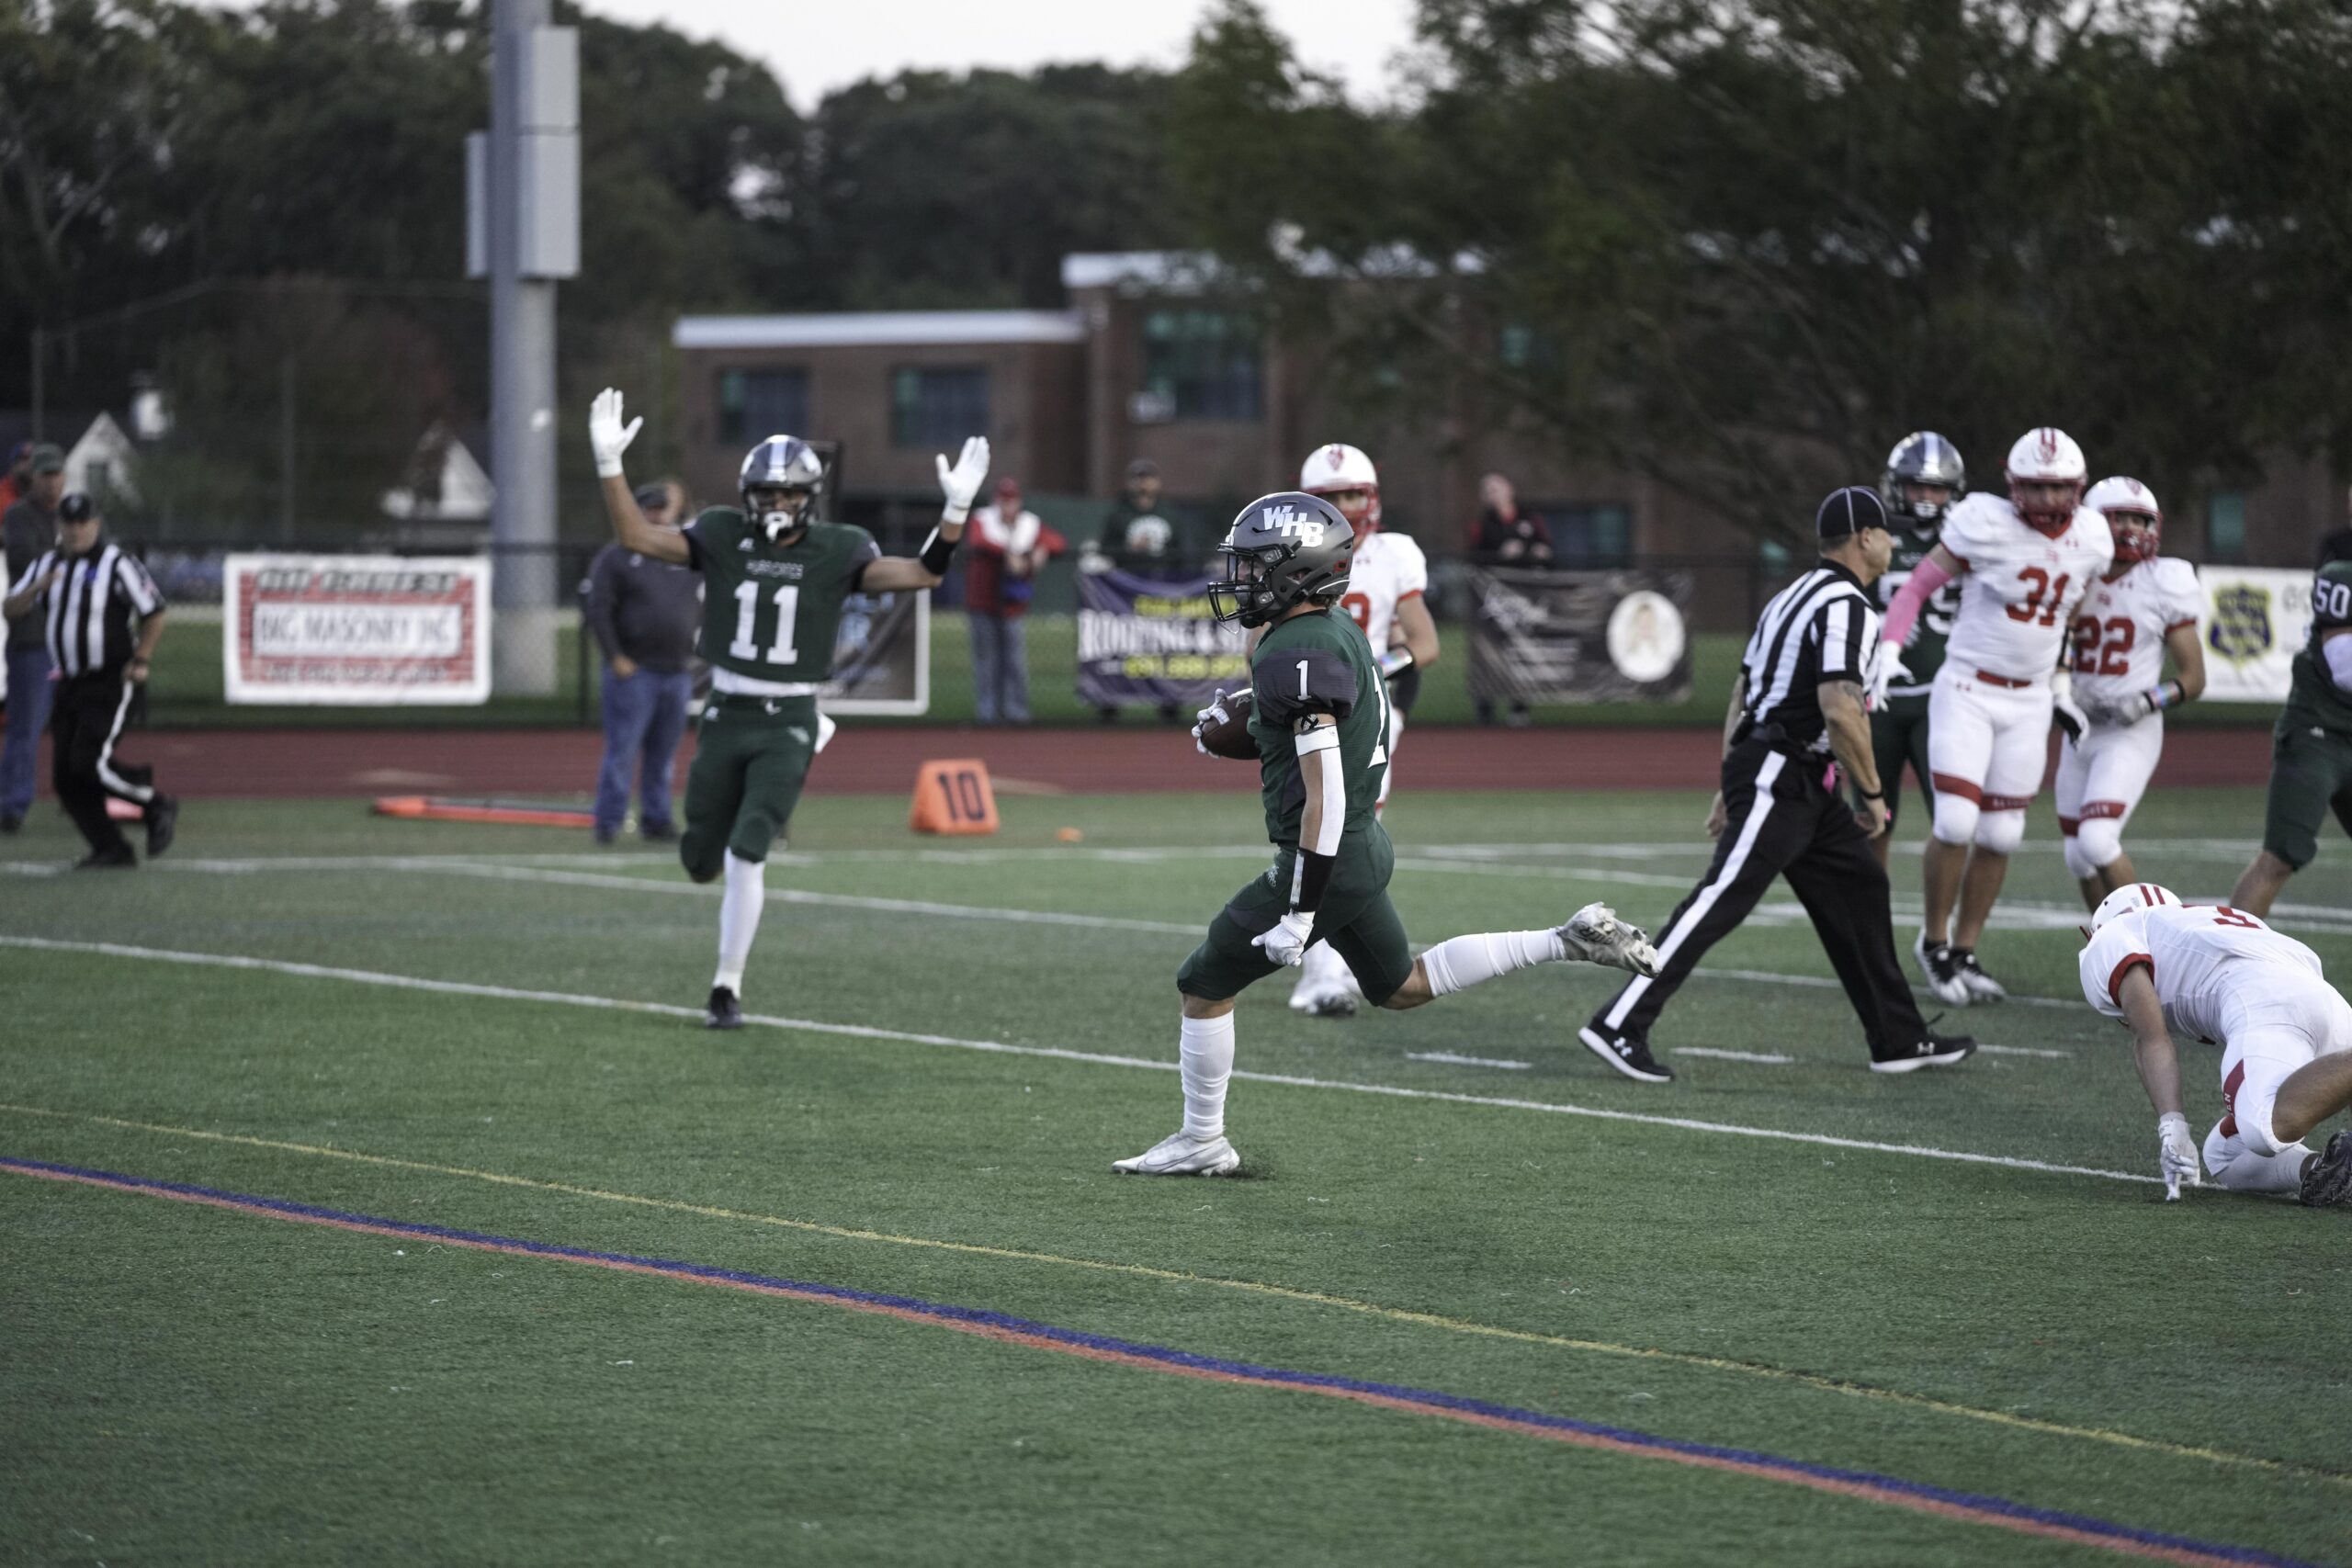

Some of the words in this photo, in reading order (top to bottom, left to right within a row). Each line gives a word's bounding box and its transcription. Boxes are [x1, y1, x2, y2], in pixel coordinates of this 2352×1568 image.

[1262, 505, 1324, 547] WHB
[729, 580, 799, 665] 11
[2005, 566, 2070, 627] 31
[2313, 577, 2351, 619] 50
[2075, 615, 2136, 676] 22
[1295, 660, 1312, 701] 1
[938, 771, 986, 823] 10
